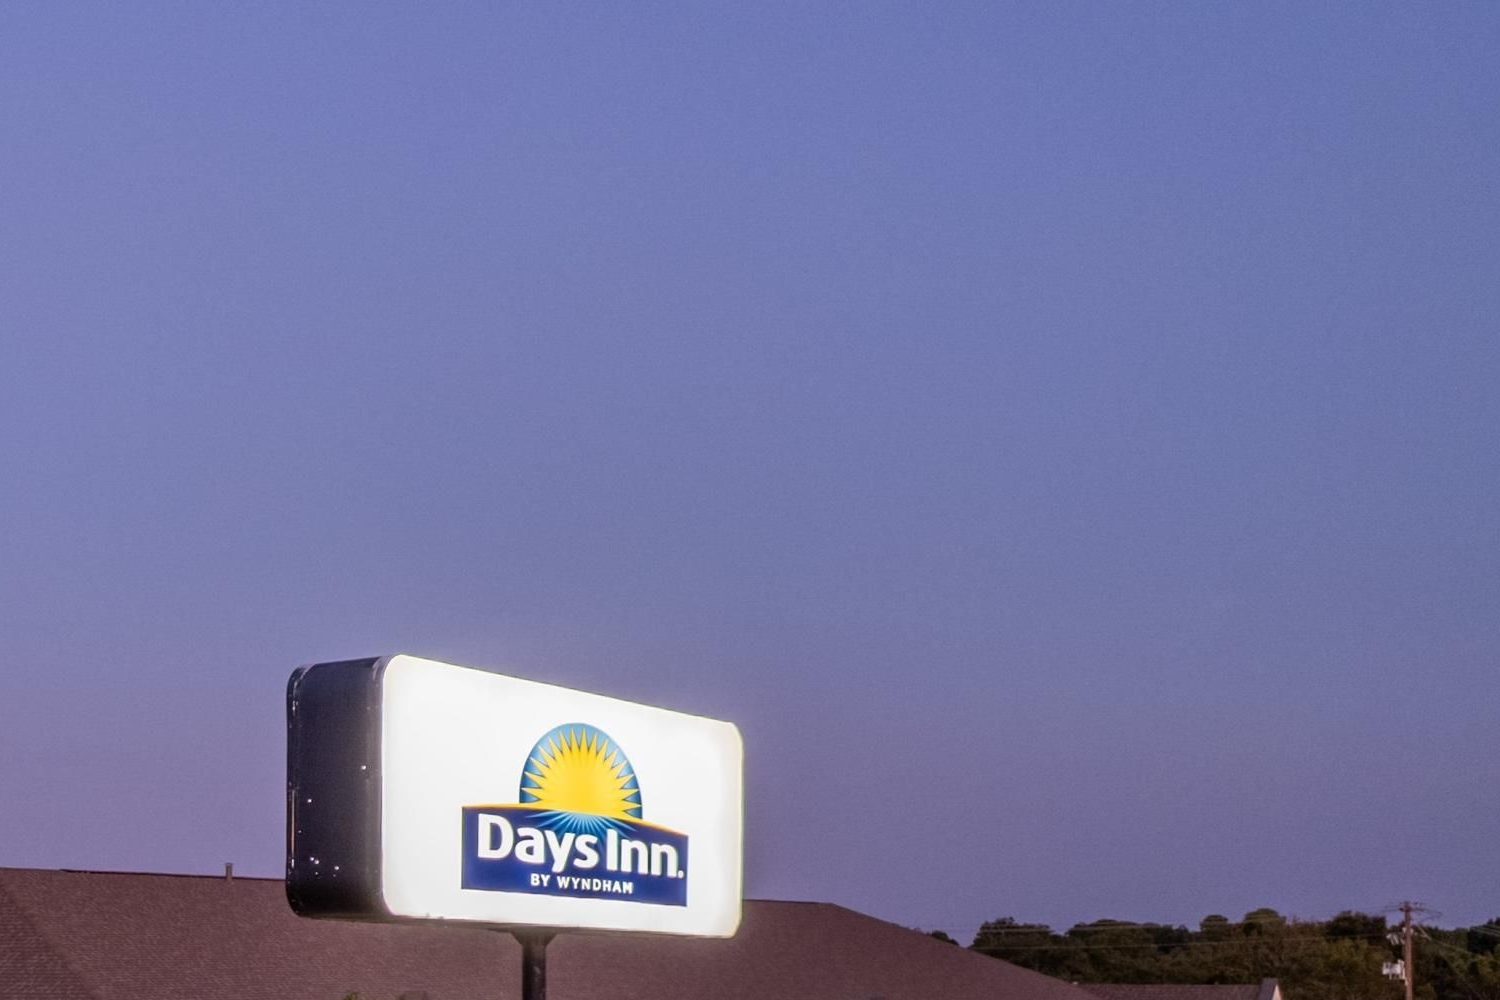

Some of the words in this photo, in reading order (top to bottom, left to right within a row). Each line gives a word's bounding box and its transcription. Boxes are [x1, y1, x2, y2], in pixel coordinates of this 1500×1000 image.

[477, 813, 599, 873] Days
[530, 873, 550, 887] BY
[557, 876, 633, 894] WYNDHAM
